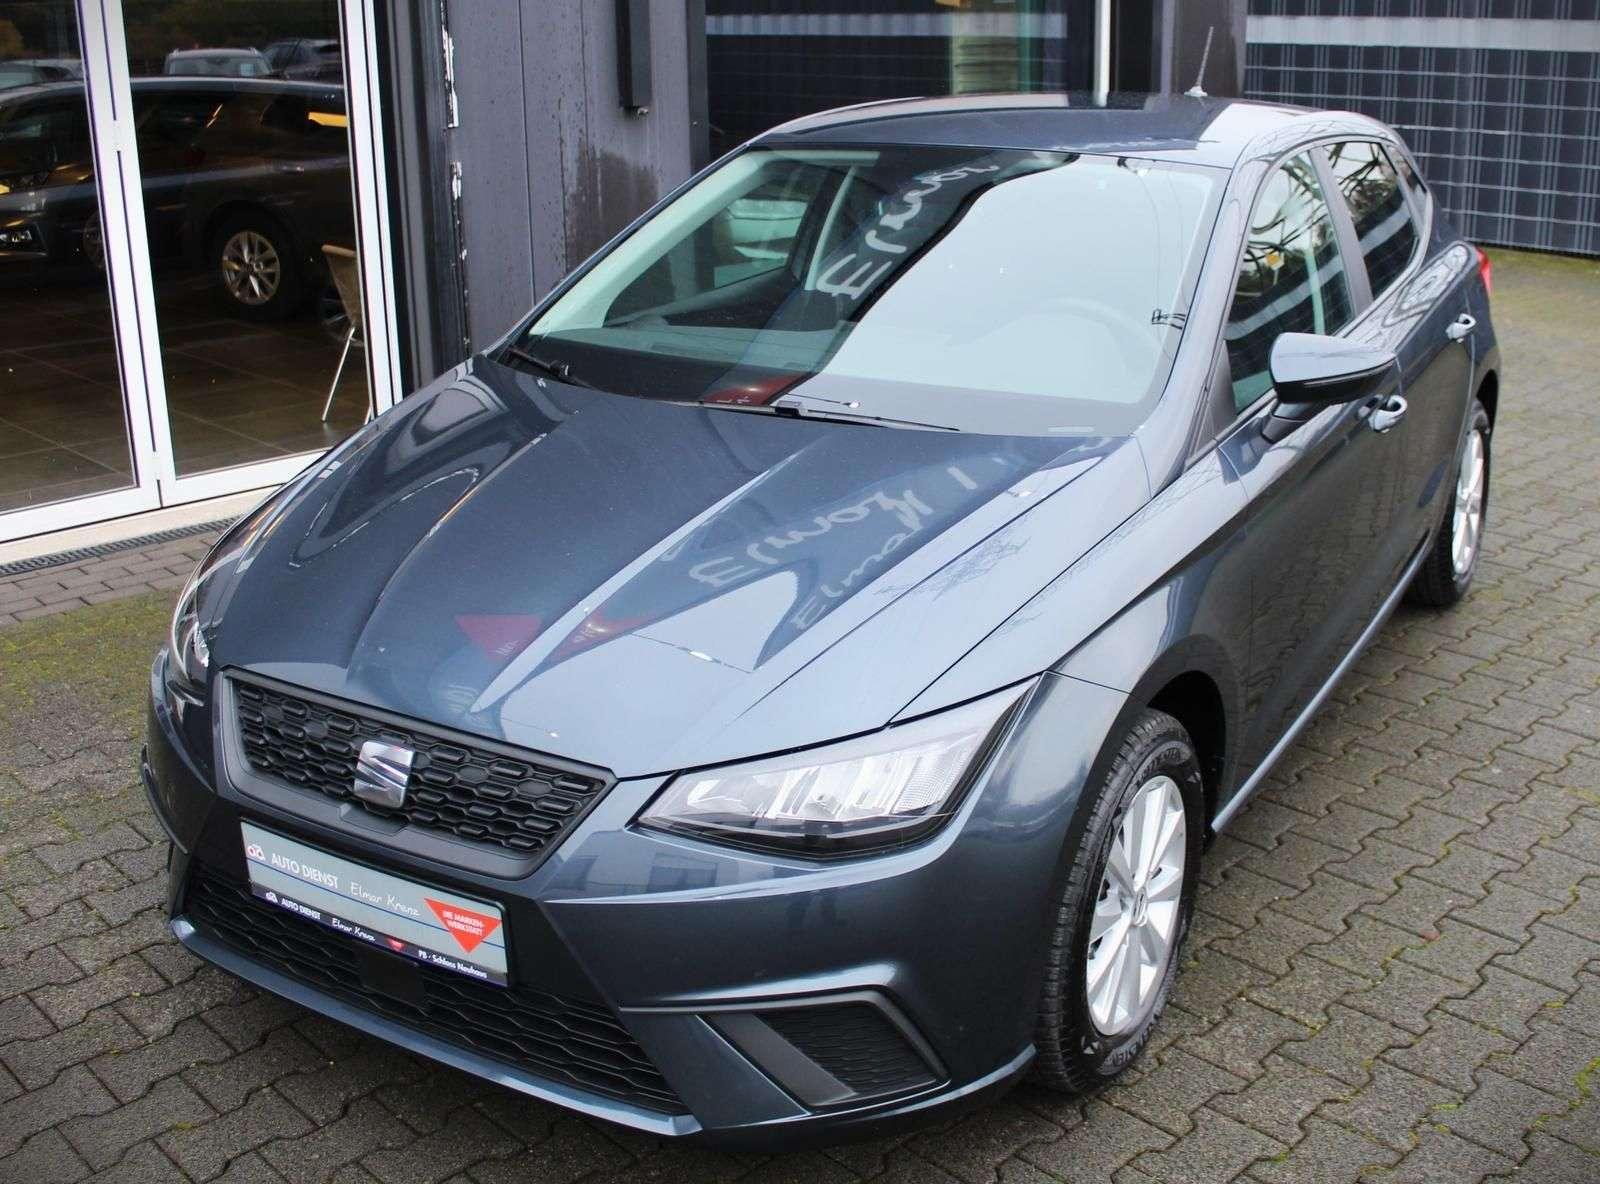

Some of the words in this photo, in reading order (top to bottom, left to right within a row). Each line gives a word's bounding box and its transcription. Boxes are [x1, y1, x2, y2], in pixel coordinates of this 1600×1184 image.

[271, 853, 300, 874] AUTO
[302, 865, 338, 889] DIENST
[350, 881, 382, 903] Elmar
[281, 898, 299, 912] AUTO
[299, 904, 321, 920] DIENST
